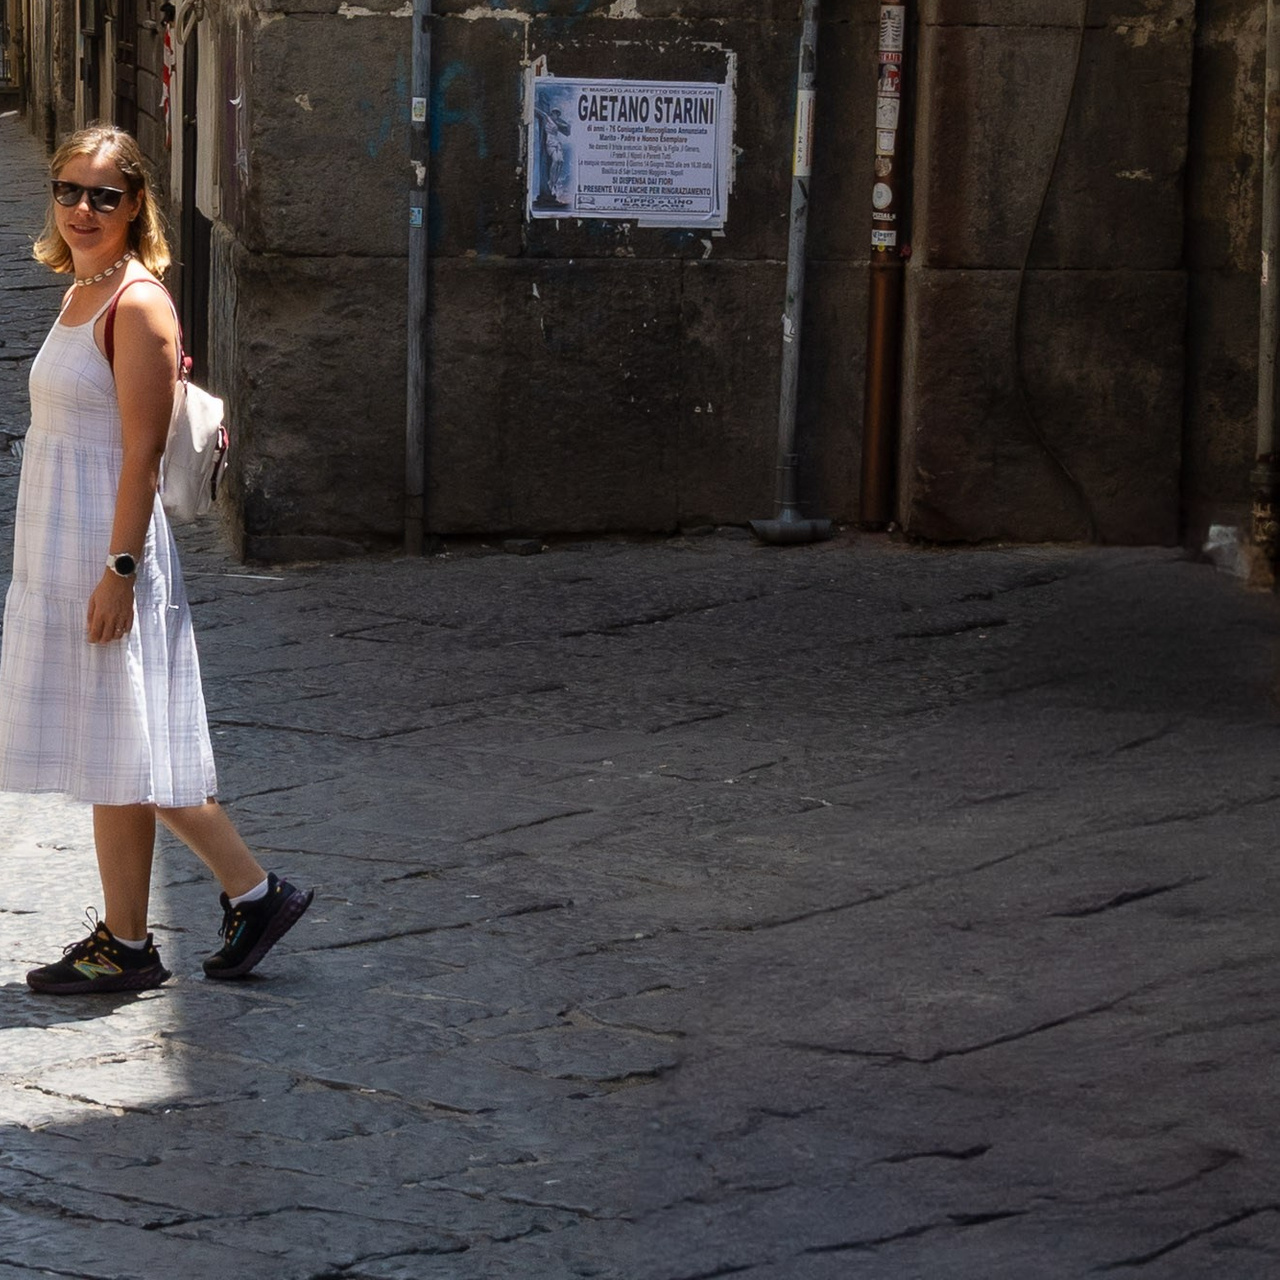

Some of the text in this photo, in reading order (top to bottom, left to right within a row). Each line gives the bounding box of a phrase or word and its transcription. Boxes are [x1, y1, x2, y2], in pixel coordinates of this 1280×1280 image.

[578, 94, 714, 124] GAETANO STARINI
[616, 125, 643, 135] Coniugato
[678, 127, 708, 135] Annunziata
[620, 134, 635, 142] Padre
[642, 135, 659, 143] Nonno
[619, 177, 646, 185] DISPENSA
[647, 177, 657, 185] DAI
[658, 178, 673, 186] FIORI
[583, 184, 613, 193] PRESENTE
[613, 185, 628, 194] VALE
[628, 185, 648, 195] ANCHE
[649, 186, 660, 195] PER
[661, 186, 711, 196] RINGRAZIAMENTO
